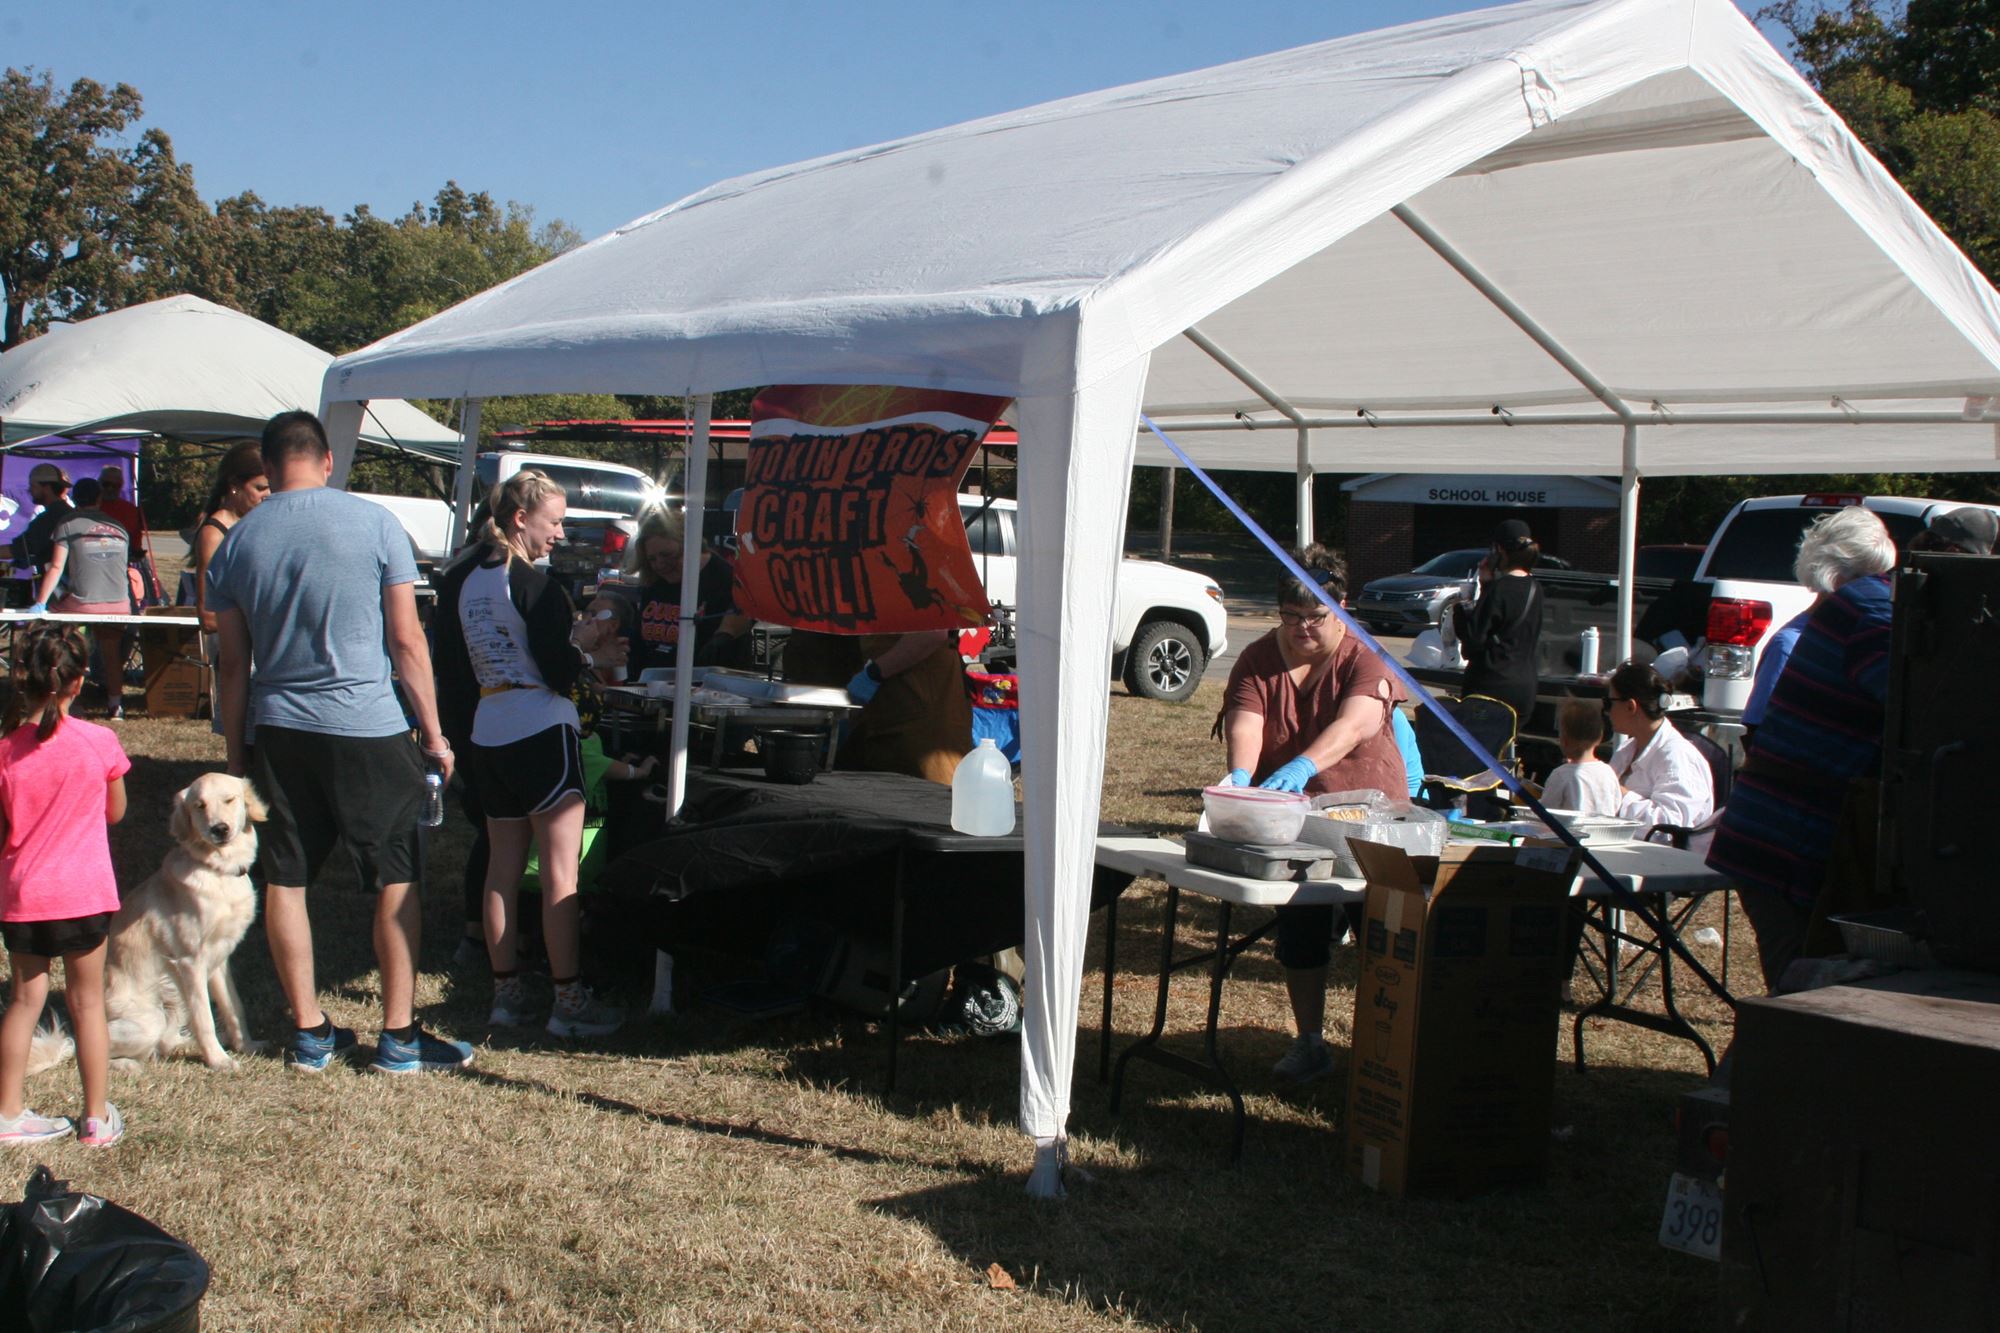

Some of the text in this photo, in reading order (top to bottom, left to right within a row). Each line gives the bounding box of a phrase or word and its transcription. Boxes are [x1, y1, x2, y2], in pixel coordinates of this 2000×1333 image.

[754, 487, 888, 546] CRAFT
[1428, 488, 1546, 503] SCHOOL HOUSE
[768, 553, 873, 619] CHILI
[1668, 1200, 1720, 1246] 398
